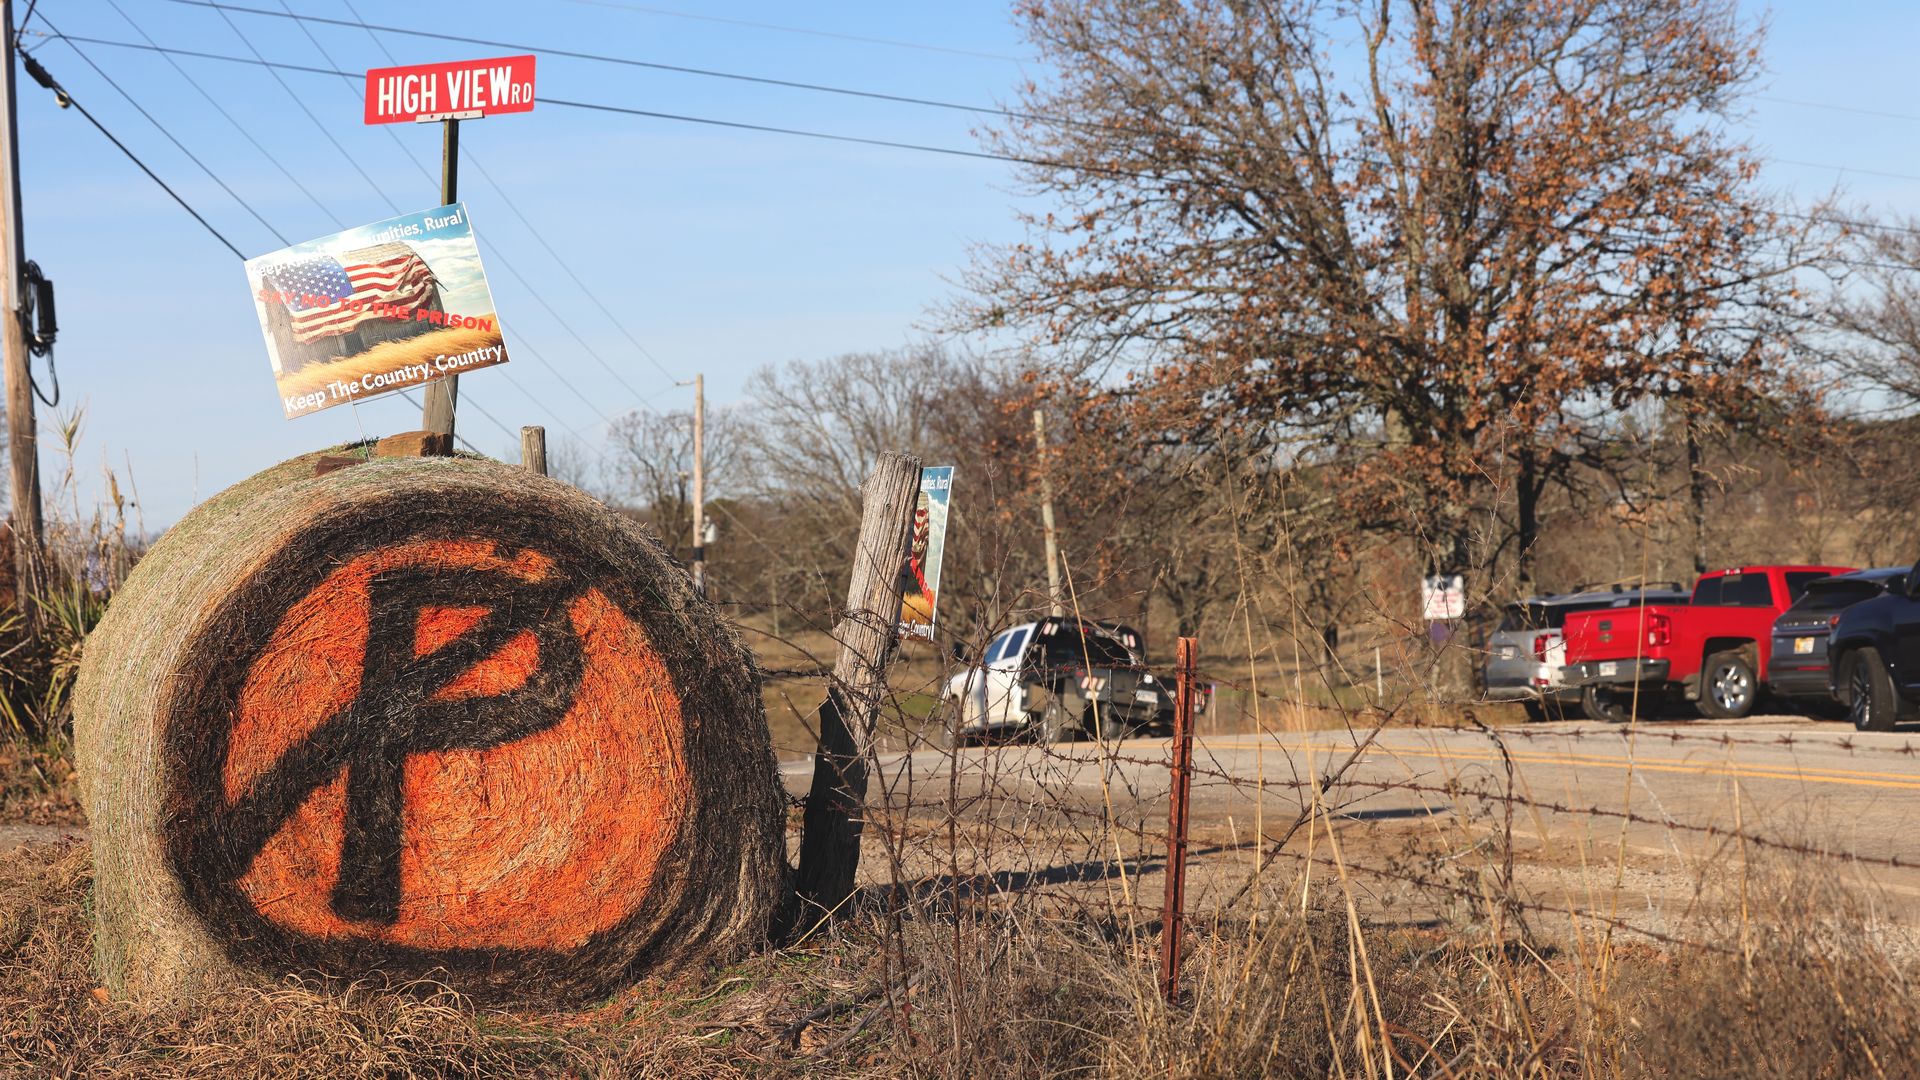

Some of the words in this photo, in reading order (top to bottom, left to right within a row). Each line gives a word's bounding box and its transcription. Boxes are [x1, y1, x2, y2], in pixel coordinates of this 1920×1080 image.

[378, 73, 437, 116] HIGH
[446, 66, 512, 110] VIEW
[511, 82, 532, 105] RD
[424, 209, 463, 232] Rural
[257, 288, 297, 306] SAY
[301, 294, 332, 309] NO
[338, 298, 364, 313] TO
[372, 301, 411, 320] THE
[416, 307, 492, 333] PRISON
[284, 390, 327, 414] Keep
[326, 380, 359, 402] The
[361, 363, 434, 391] Country,
[436, 344, 503, 372] Country
